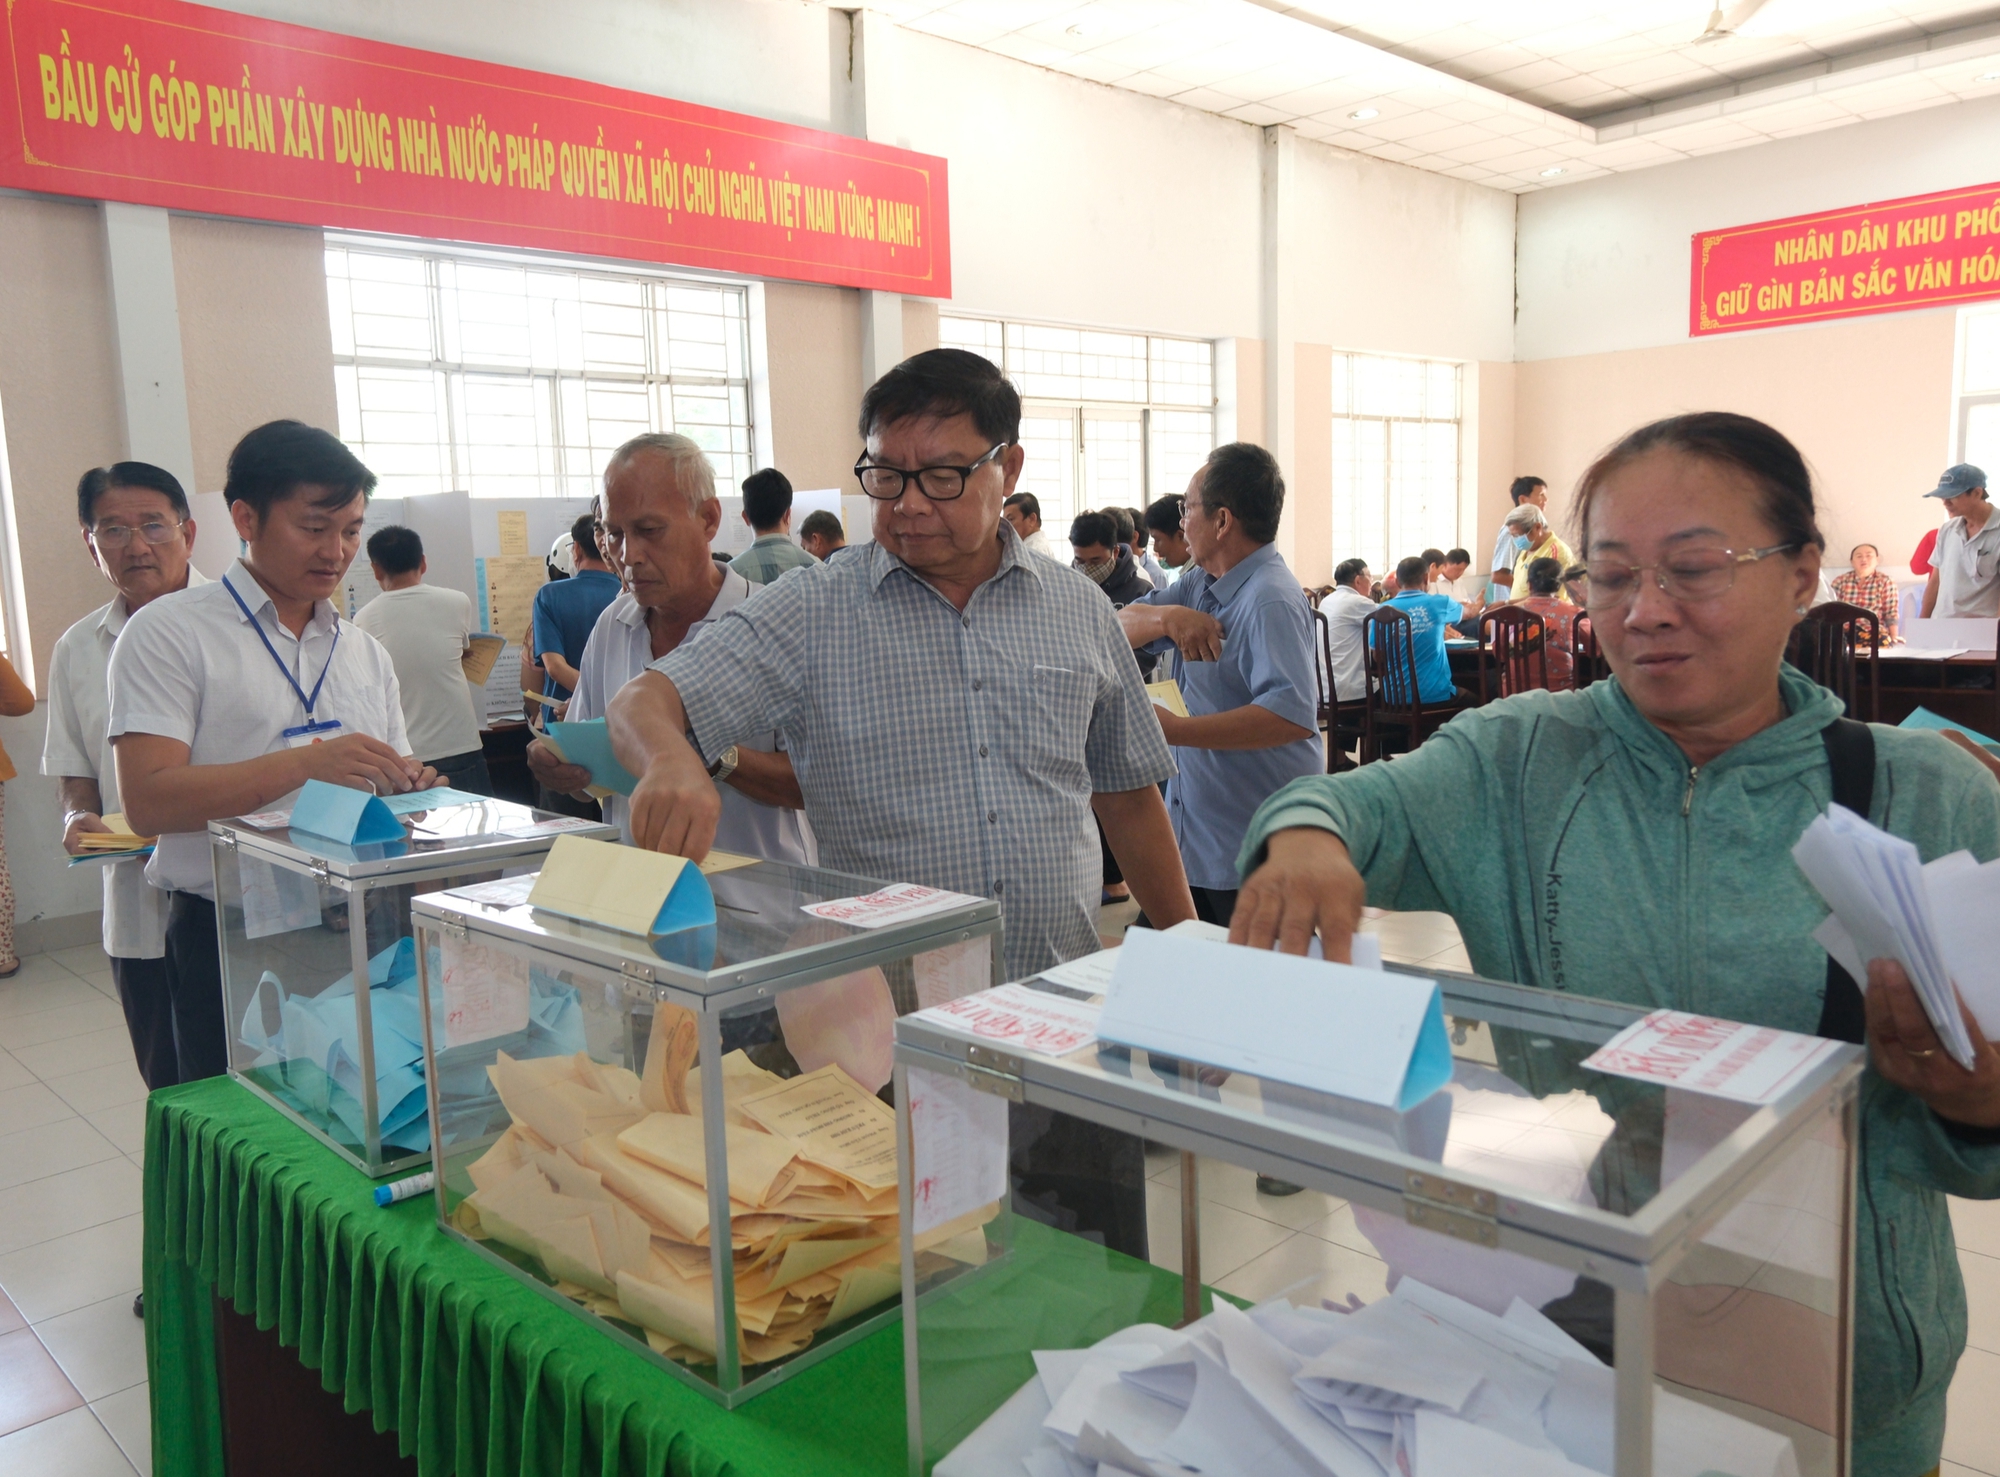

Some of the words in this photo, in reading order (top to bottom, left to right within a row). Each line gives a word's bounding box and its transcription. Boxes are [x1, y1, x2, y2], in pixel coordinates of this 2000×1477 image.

[39, 29, 98, 127] BẦU
[104, 44, 142, 134] CỬ
[148, 59, 202, 142] GÓP
[206, 63, 276, 154] PHẦN
[278, 85, 326, 161] XÂY
[331, 98, 395, 184] DỰNG
[398, 105, 445, 177] NHÀ
[446, 113, 503, 186] NƯỚC
[506, 122, 556, 191] PHÁP
[559, 125, 621, 201] QUYỀN
[623, 140, 648, 205] XÃ
[650, 148, 679, 224] HỘI
[682, 149, 716, 216] CHỦ
[718, 161, 767, 223] NGHĨA
[768, 170, 802, 242] VIỆT
[804, 185, 836, 234] NAM
[837, 180, 875, 241] VỮNG
[876, 198, 914, 257] MẠNH
[1774, 228, 1834, 267] NHÂN
[1841, 219, 1889, 257] DÂN
[1895, 214, 1947, 248] KHU
[1715, 282, 1753, 317] GIỮ
[1756, 277, 1793, 312] GÌN
[1799, 267, 1846, 306] BẢN
[1851, 257, 1897, 299] SẮC
[1904, 256, 1953, 292] VĂN
